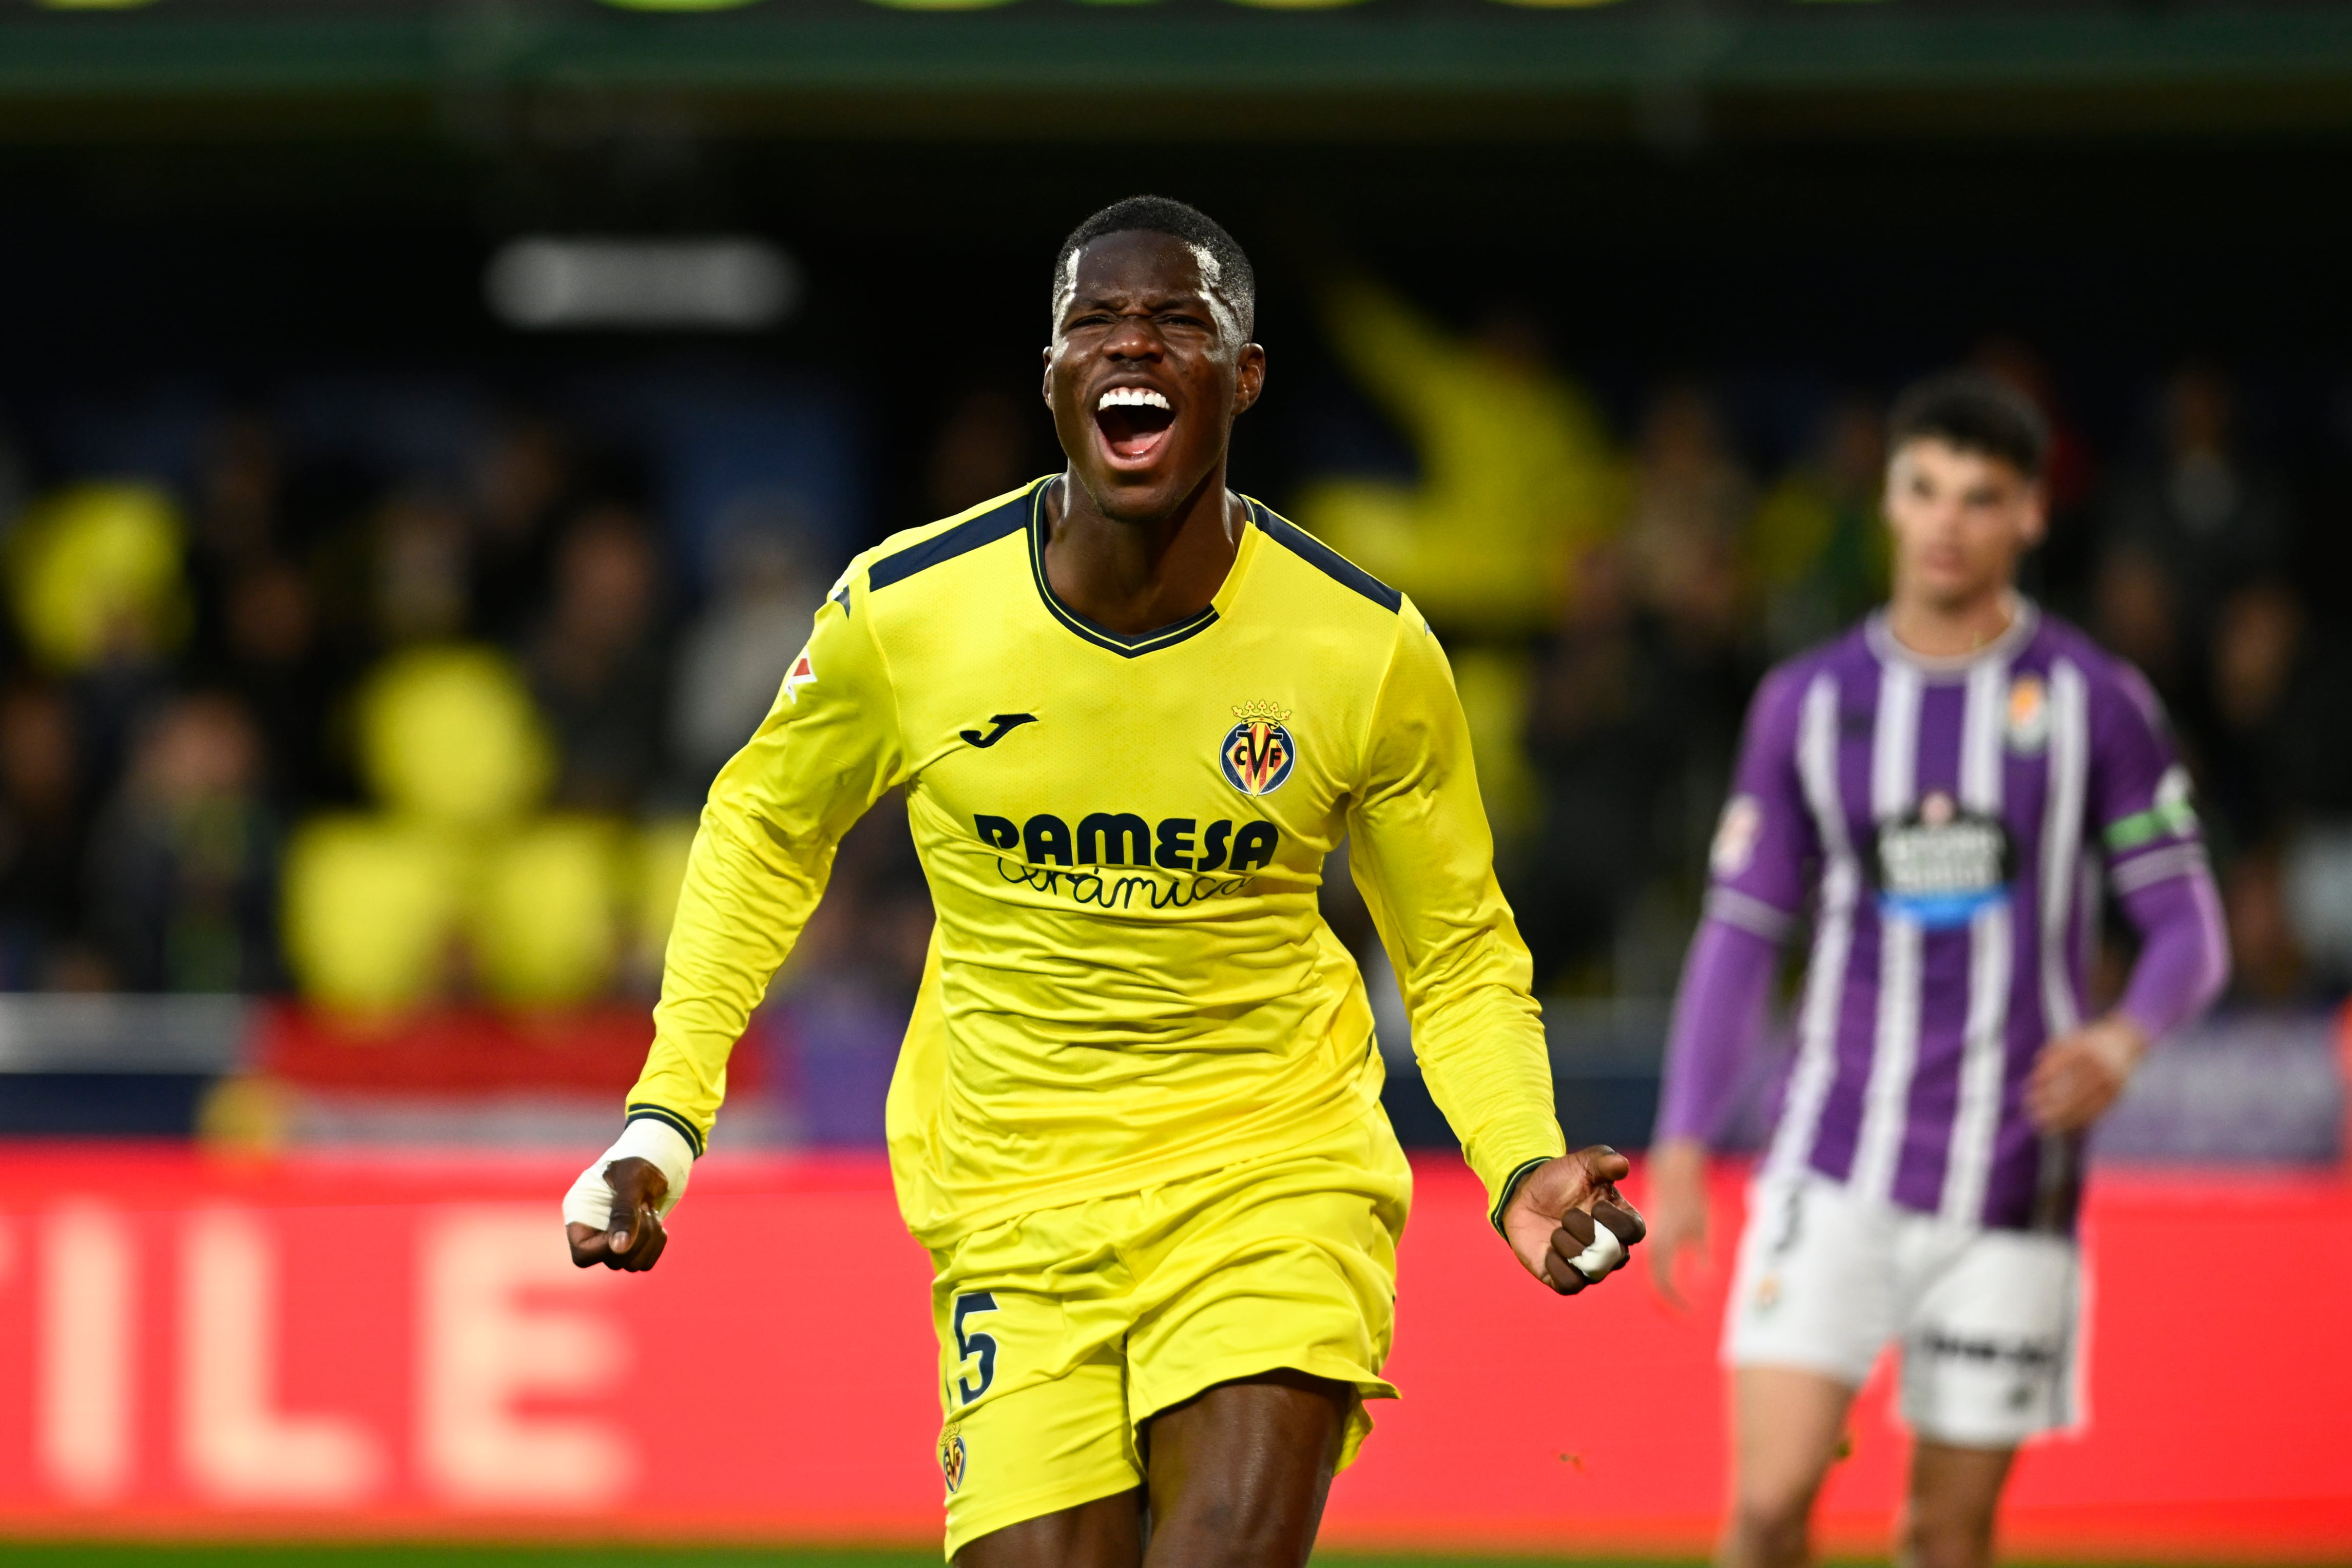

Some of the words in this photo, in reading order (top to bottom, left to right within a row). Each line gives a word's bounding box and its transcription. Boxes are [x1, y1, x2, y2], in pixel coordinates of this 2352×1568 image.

[973, 812, 1279, 872] PAMESA
[0, 1201, 642, 1504] ILE
[953, 1292, 999, 1406] 5
